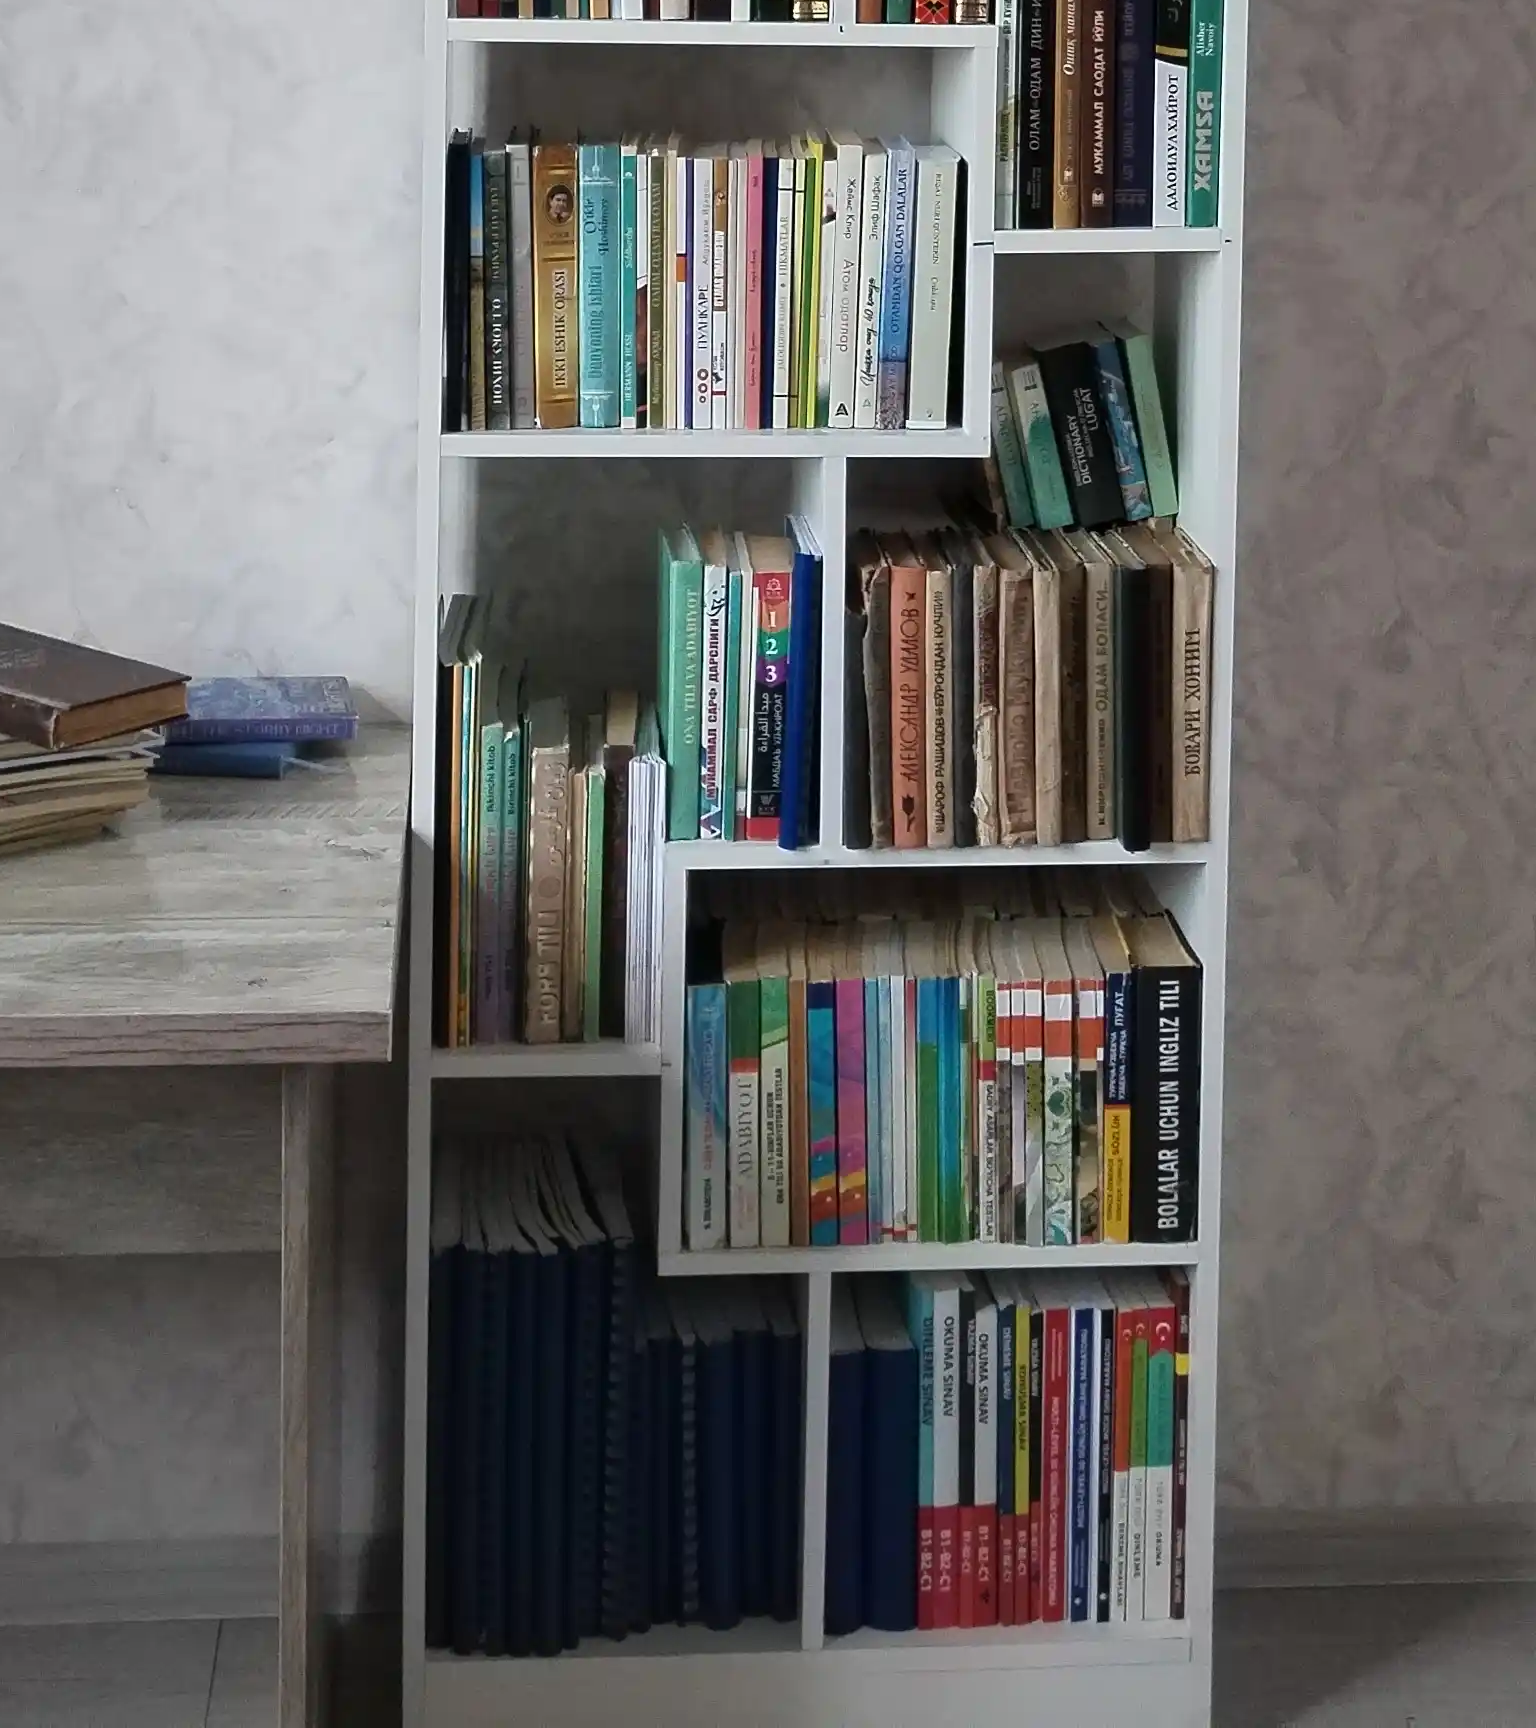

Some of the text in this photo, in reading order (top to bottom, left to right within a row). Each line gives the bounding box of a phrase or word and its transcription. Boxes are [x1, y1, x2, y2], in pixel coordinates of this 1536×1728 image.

[1029, 17, 1046, 52] ДИН
[1061, 40, 1079, 78] Ошиқ
[1194, 22, 1207, 58] Alisher
[1204, 23, 1218, 59] Navoiy
[1028, 57, 1045, 100] ОДАМ
[1090, 11, 1106, 177] МУКАММАЛ САОДАТ ЙЎЛИ
[1028, 108, 1044, 153] ОЛАМ
[1165, 75, 1181, 213] ДАЛОИЛУЛ ХАЙРОТ
[1192, 92, 1215, 194] XAMSA
[868, 175, 882, 242] Элиф Шафақ
[777, 217, 789, 278] HIKMATLAR
[842, 258, 855, 293] Атом
[888, 169, 907, 334] OTAMDAN QOLGAN DALALAR
[553, 270, 566, 387] IKKI ESHIK ORASI
[836, 296, 853, 352] одатлар
[623, 361, 634, 403] HERMANN
[1078, 387, 1100, 432] LUGAT
[1066, 413, 1093, 485] DICTIONARY
[683, 588, 698, 746] ONA TILI VA ADABIYOT
[764, 665, 778, 683] 3
[765, 637, 779, 656] 2
[705, 618, 721, 800] МУКАММАЛ САРФ ДАРСЛИГИ
[1095, 664, 1110, 713] ОДАМ
[1183, 629, 1201, 778] БОВАРИ ХОНИМ
[485, 745, 497, 769] kitob
[898, 683, 921, 784] АЛЕКСАНДР
[933, 717, 946, 779] РАШИДОВ
[506, 753, 518, 778] kitob
[539, 961, 562, 1027] FORS
[1157, 980, 1181, 1230] BOLALAR UCHUN INGLIZ TILI
[1002, 1327, 1013, 1368] DENEME
[938, 1316, 956, 1593] OKUMA SINAV B1-B2-C1
[977, 1332, 990, 1582] OKUMA SINAV B1-B2-C1
[919, 1528, 933, 1592] B1-B2-C1
